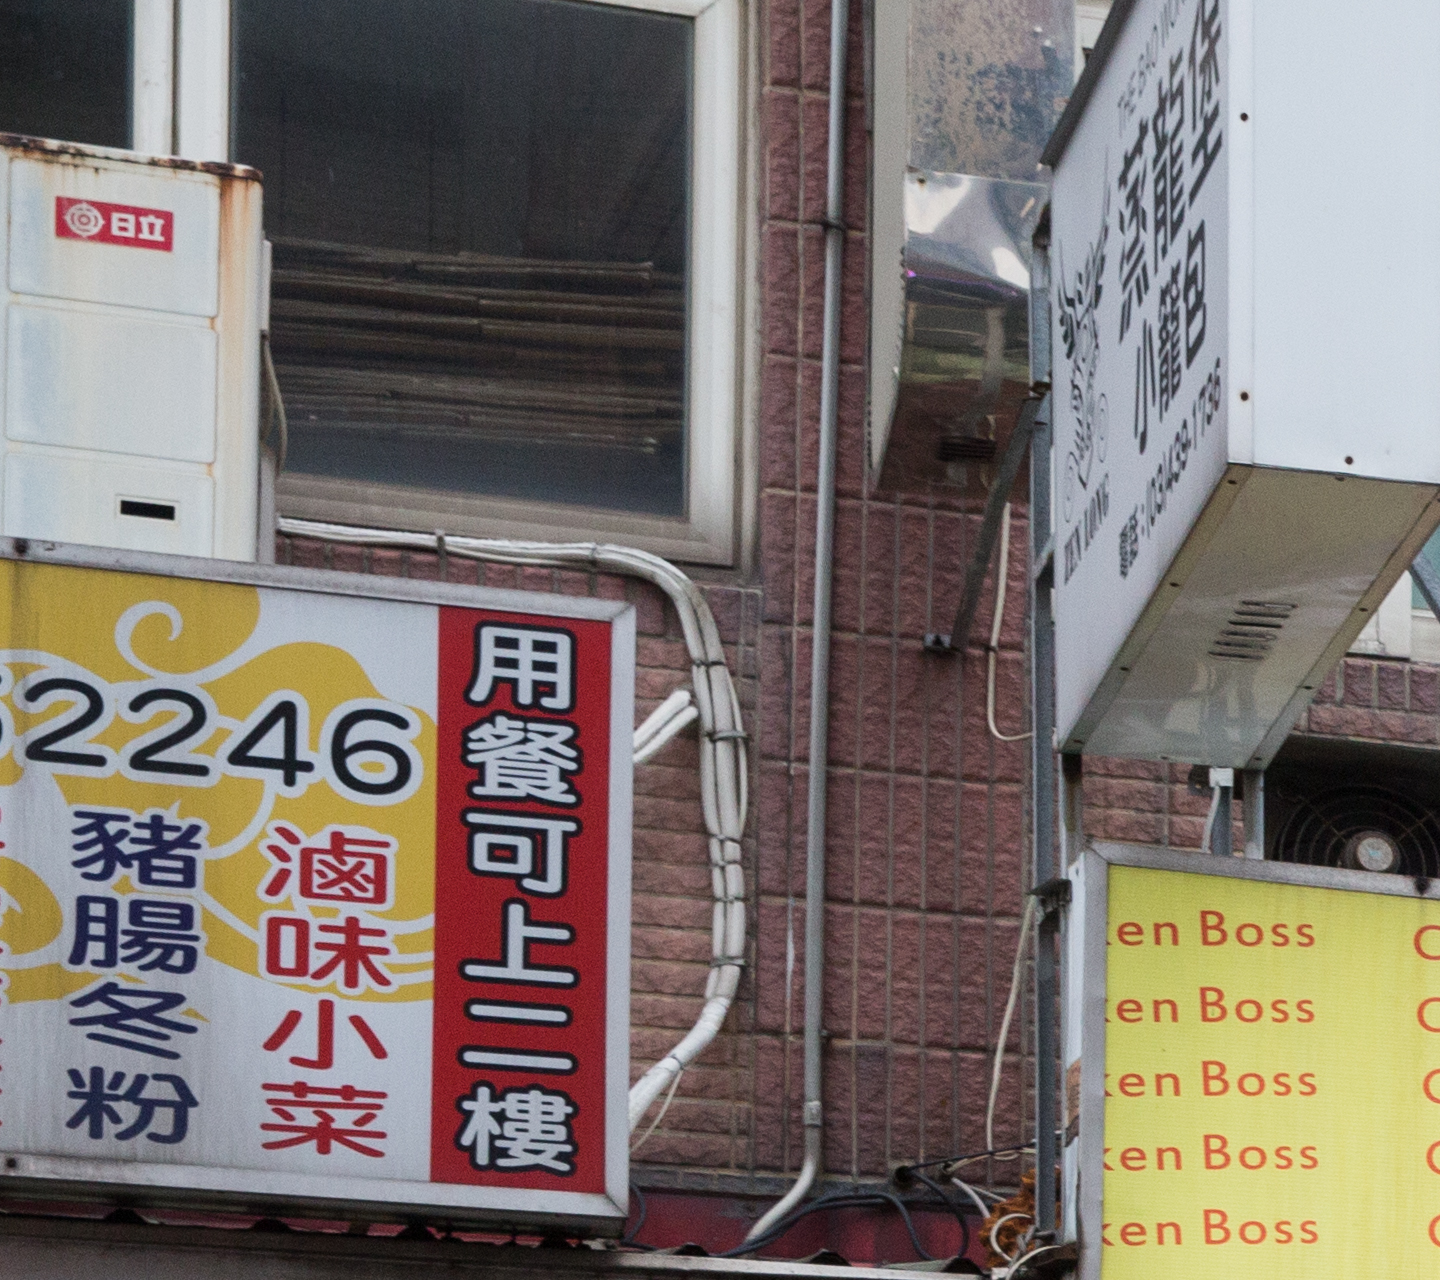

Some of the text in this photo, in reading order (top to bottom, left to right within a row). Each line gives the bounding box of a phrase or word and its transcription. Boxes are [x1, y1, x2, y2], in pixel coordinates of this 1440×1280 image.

[110, 211, 166, 242] 日立
[0, 676, 413, 798] 2246
[460, 622, 581, 1178] 用餐可上二樓
[1200, 910, 1314, 947] Boss
[66, 810, 202, 1146] 豬腸冬粉
[260, 825, 393, 1157] 滷味小菜
[1199, 987, 1314, 1023] Boss
[1202, 1060, 1317, 1096] Boss
[1203, 1134, 1318, 1170] Boss
[1203, 1209, 1318, 1245] Boss
